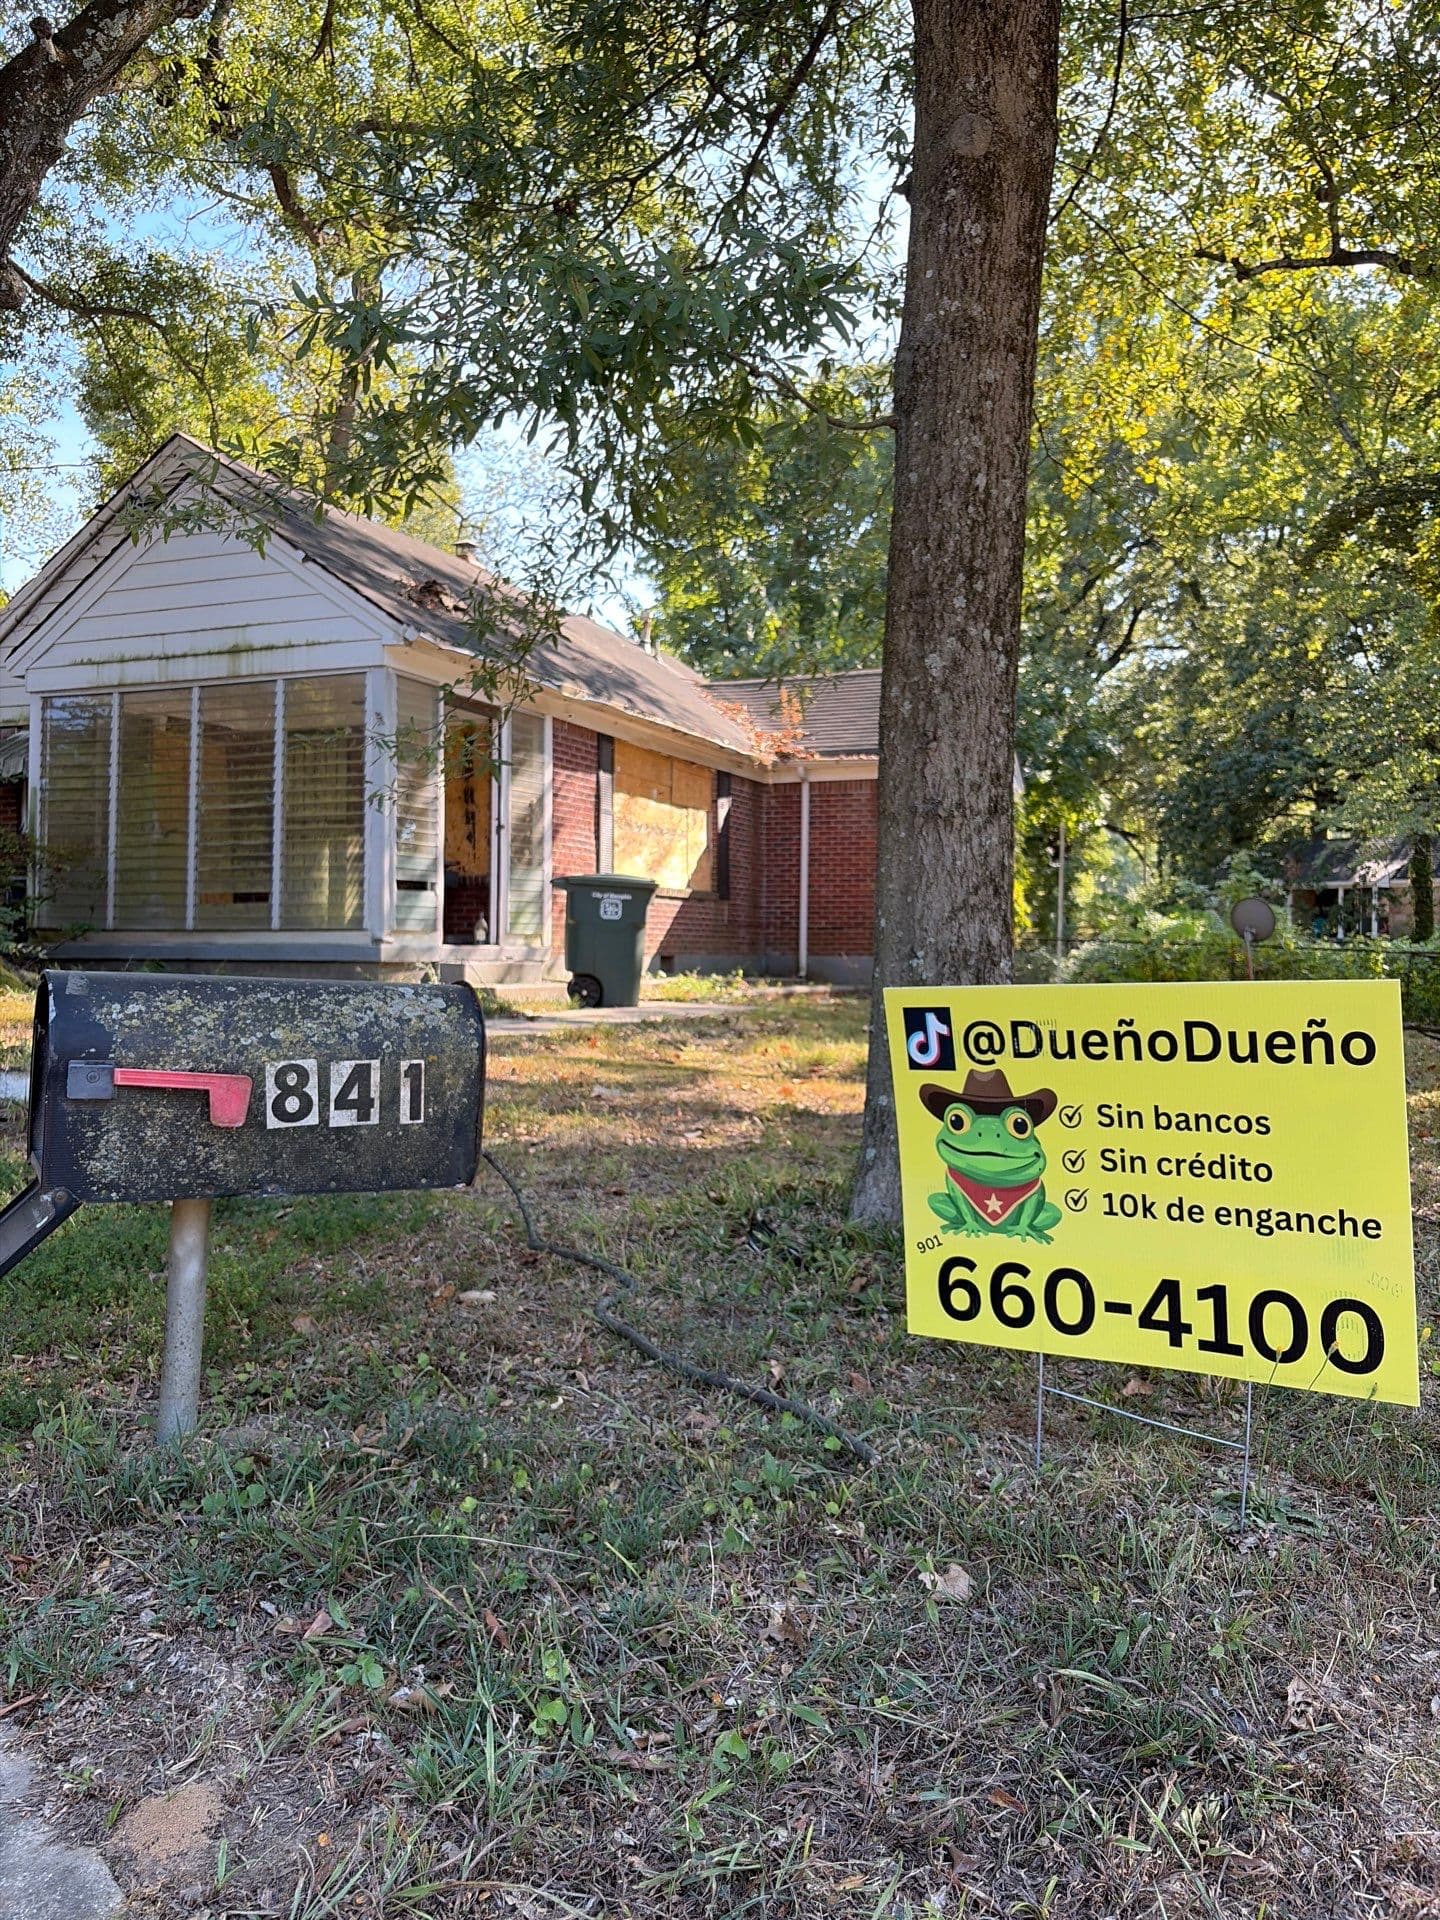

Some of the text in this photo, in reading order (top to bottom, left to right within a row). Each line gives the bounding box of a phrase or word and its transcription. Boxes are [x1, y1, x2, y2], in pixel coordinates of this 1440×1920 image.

[963, 1018, 1377, 1067] @DueñoDueño
[271, 1062, 422, 1123] 841
[1097, 1103, 1271, 1136] Sin bancos
[1100, 1148, 1273, 1183] Sin crédito
[1102, 1192, 1382, 1240] 10k de enganche
[916, 1234, 944, 1254] 901
[937, 1256, 1385, 1375] 660-4100
